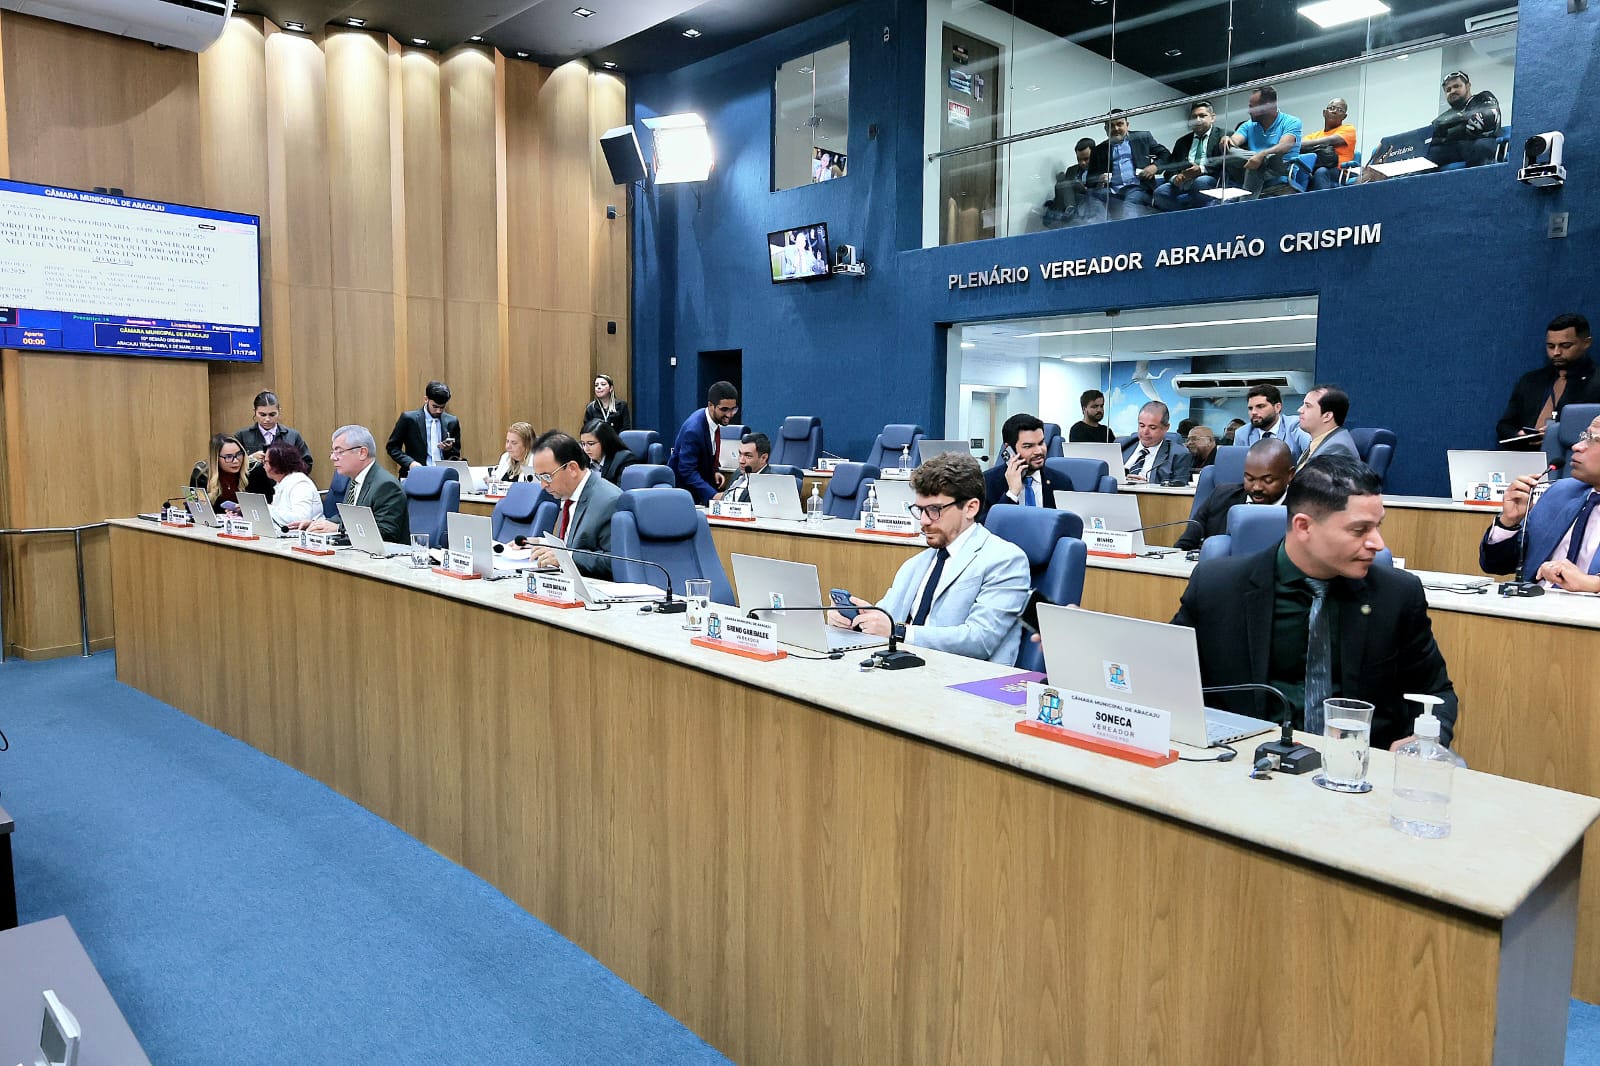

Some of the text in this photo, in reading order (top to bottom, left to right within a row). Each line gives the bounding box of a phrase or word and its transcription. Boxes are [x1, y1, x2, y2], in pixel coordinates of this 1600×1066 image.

[45, 188, 165, 212] CÂMARA MUNICIPAL DE ARACAJU
[948, 223, 1382, 290] PLENÁRIO VEREADOR ABRAHÃO CRISPIM
[22, 337, 46, 345] 00:00
[1071, 695, 1093, 704] CÂMARA
[1094, 700, 1123, 711] MUNICIPAL
[1133, 708, 1160, 718] ARACAJU
[1095, 711, 1132, 728] SONECA
[1092, 722, 1136, 738] VEREADOR
